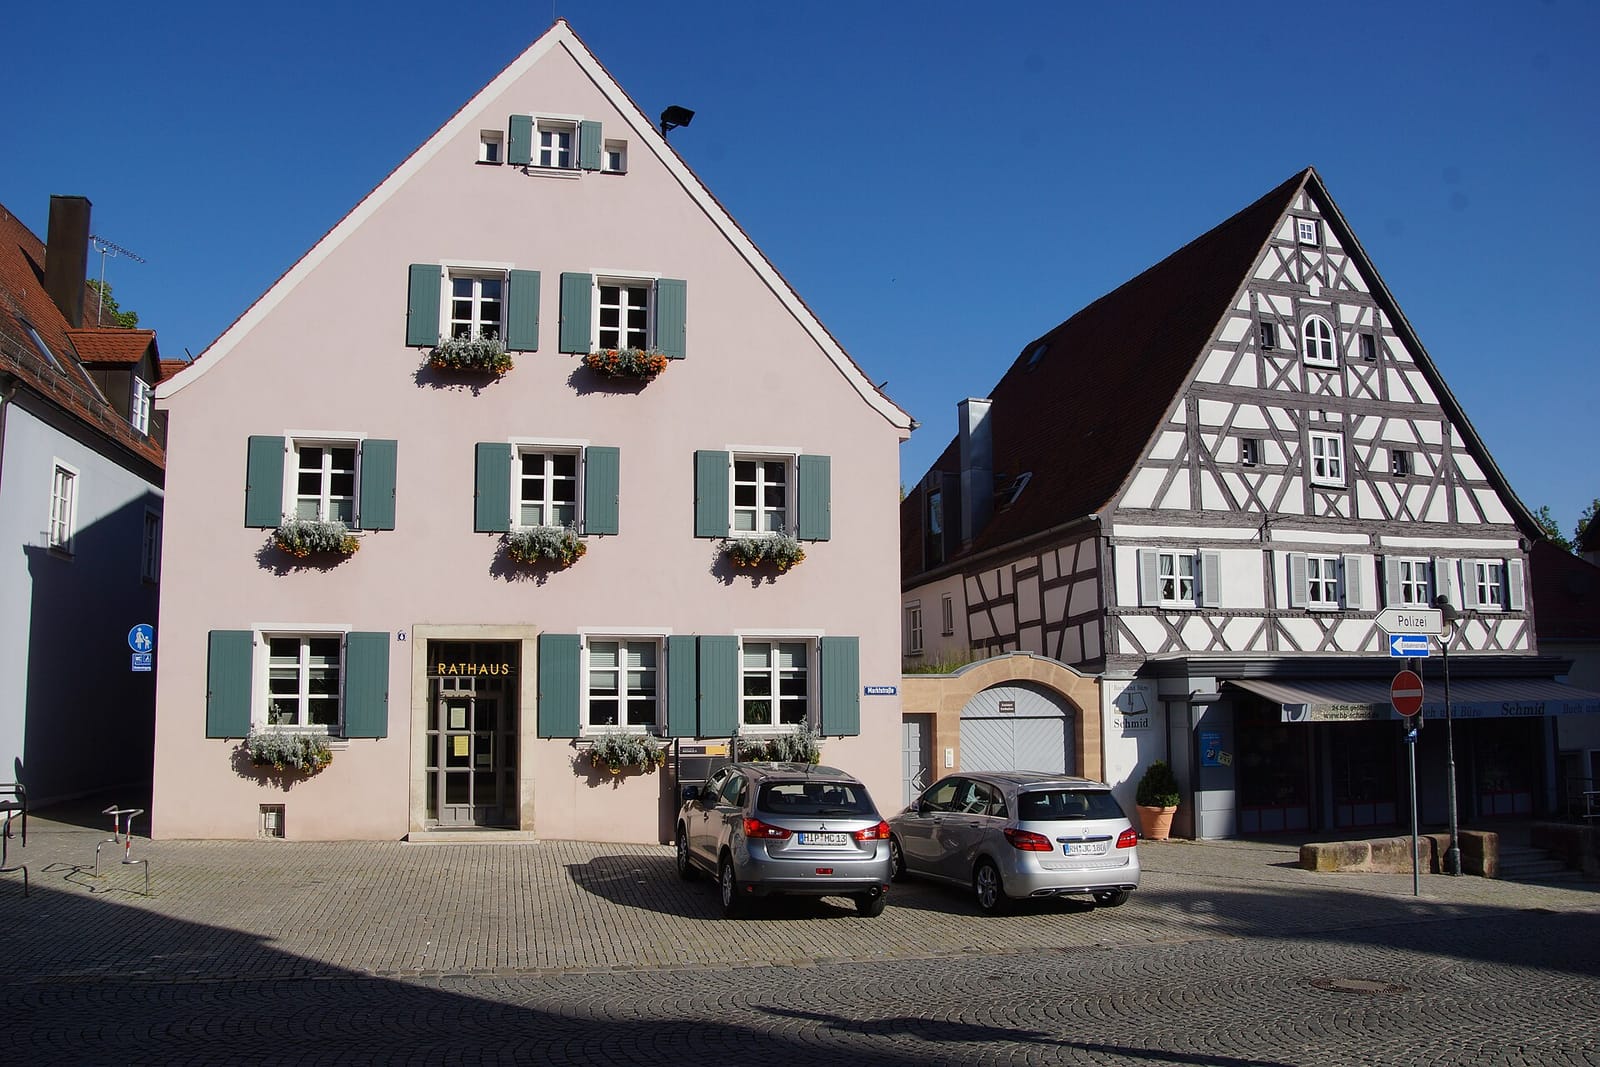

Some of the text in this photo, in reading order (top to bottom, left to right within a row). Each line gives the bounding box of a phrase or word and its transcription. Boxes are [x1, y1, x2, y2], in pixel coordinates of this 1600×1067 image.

[1397, 615, 1427, 627] Polizei
[438, 663, 509, 675] RATHAUS
[1501, 702, 1545, 716] Schmid
[1113, 717, 1149, 728] Schmid
